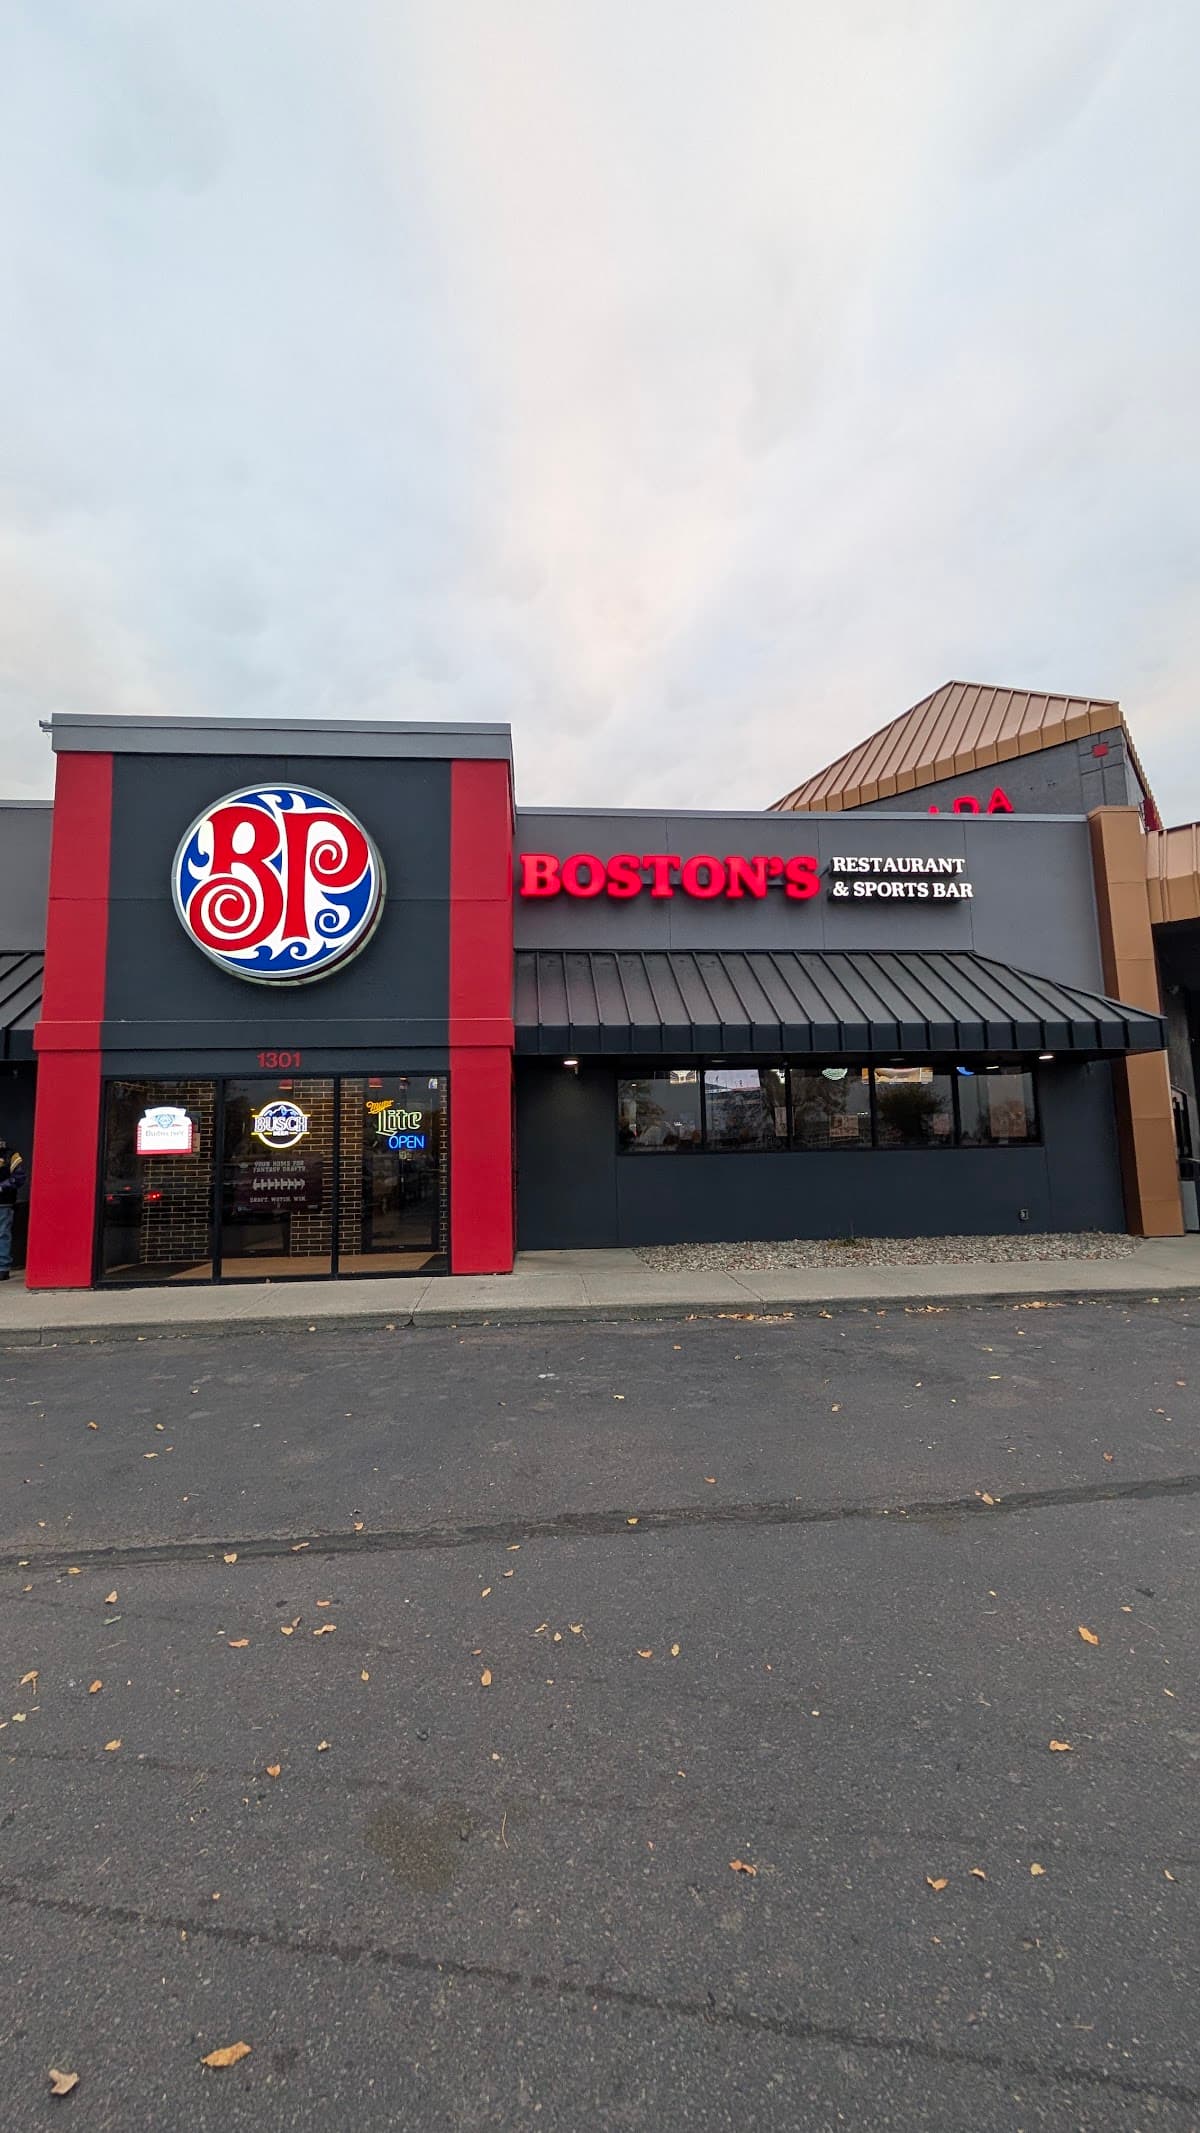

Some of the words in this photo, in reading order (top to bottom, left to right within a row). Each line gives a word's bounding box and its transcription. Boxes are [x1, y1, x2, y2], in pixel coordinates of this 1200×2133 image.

[832, 856, 966, 873] RESTAURANT
[189, 805, 369, 952] BP
[520, 854, 821, 899] BOSTON'S
[832, 881, 850, 897] &
[853, 881, 929, 897] SPORTS
[932, 882, 974, 898] BAR
[257, 1052, 302, 1069] 1301
[254, 1116, 308, 1132] BUSCH
[376, 1109, 422, 1136] Lite
[388, 1135, 425, 1149] OPEN
